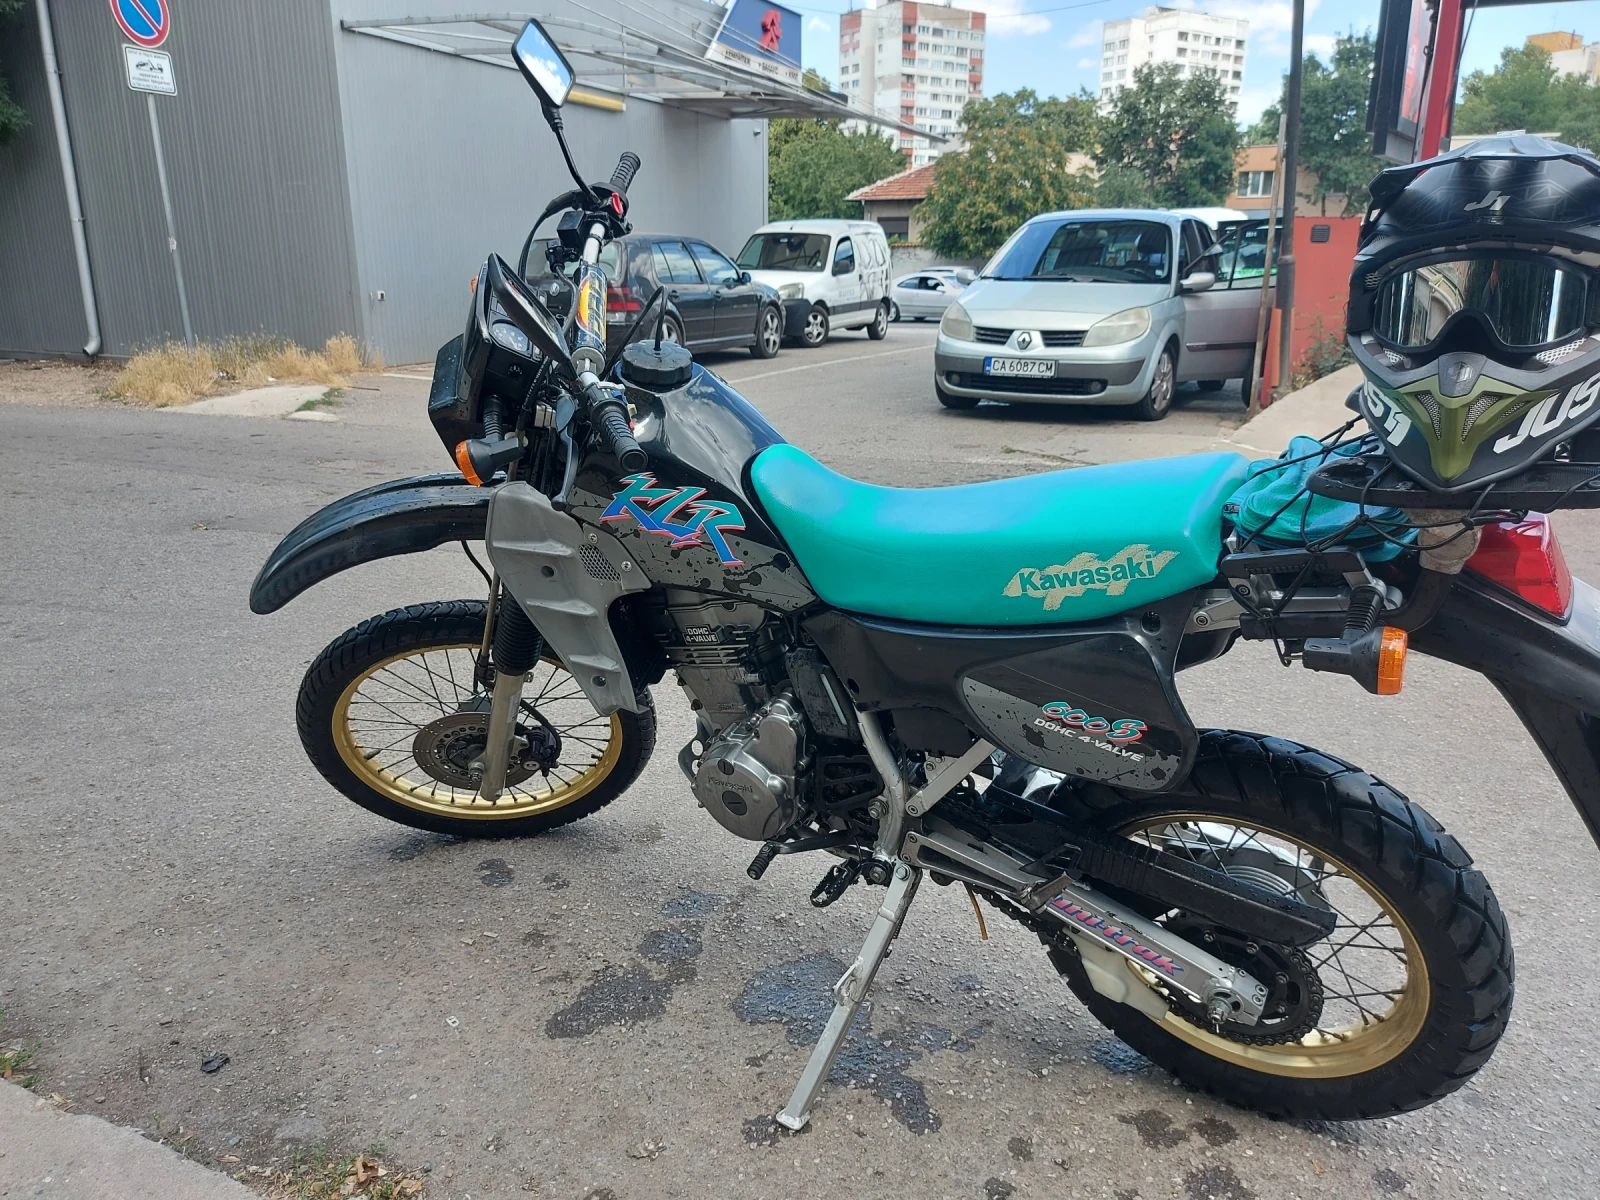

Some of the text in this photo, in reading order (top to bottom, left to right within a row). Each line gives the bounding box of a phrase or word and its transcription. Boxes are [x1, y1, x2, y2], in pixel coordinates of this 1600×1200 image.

[992, 359, 1053, 374] CA 6087 CM
[599, 471, 746, 567] KLR
[1018, 553, 1155, 593] Kawasaki
[685, 634, 718, 642] 4-VALVE
[687, 627, 709, 635] DOHC
[1033, 717, 1144, 762] DOHC 4-VALVE
[1042, 701, 1148, 742] 600S
